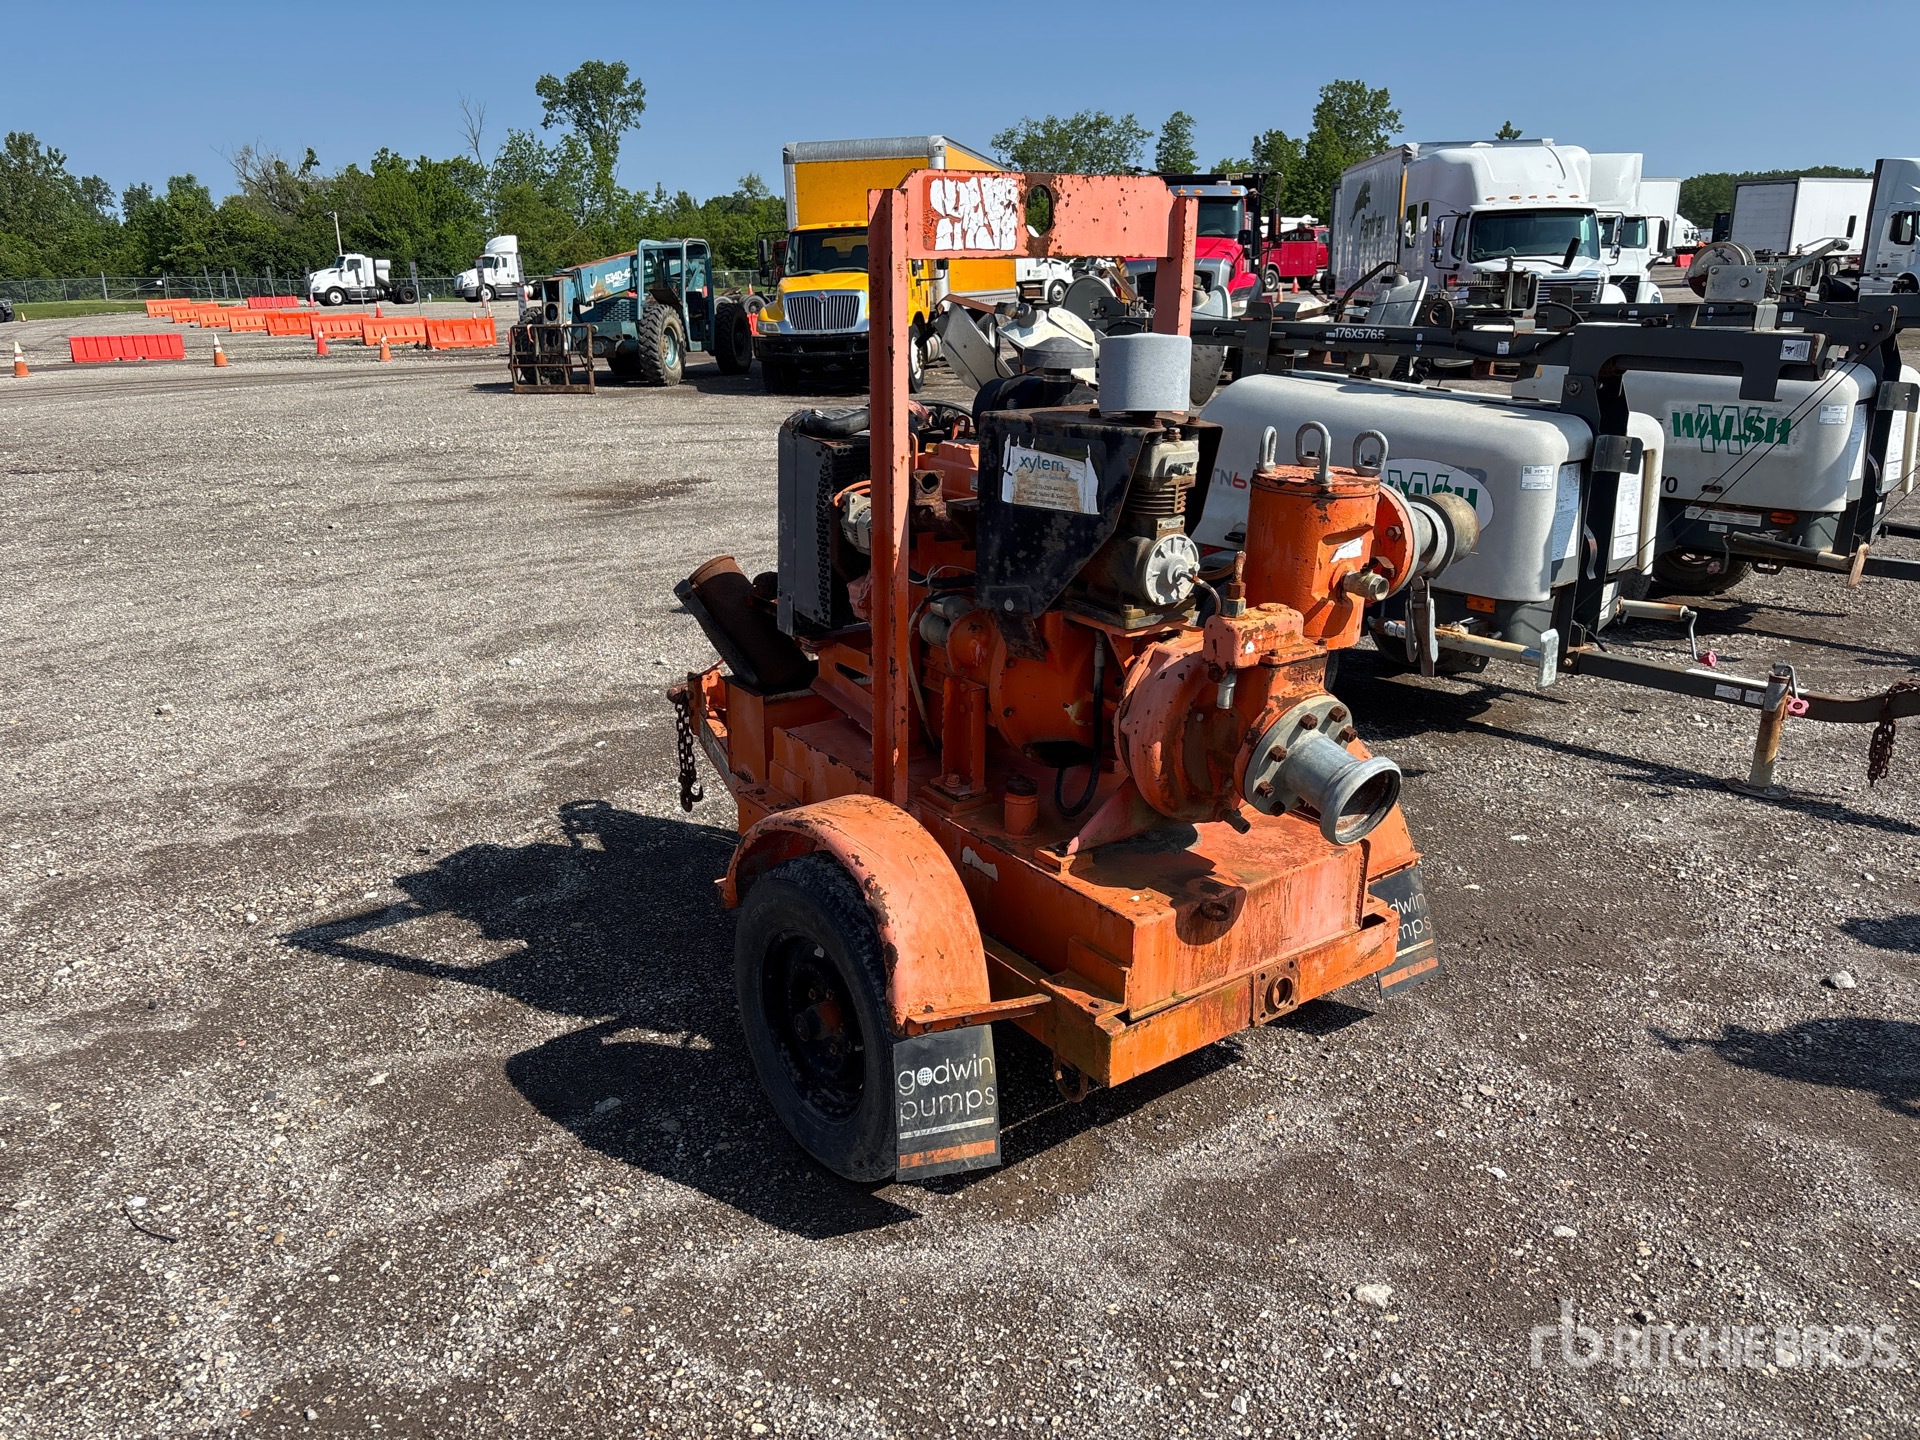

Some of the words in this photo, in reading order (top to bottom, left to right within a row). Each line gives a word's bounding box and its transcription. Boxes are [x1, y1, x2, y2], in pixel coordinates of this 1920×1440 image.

[1671, 411, 1792, 449] WALSH
[1019, 455, 1065, 473] xylem
[1389, 892, 1428, 916] dwin
[1398, 916, 1432, 942] mps
[897, 1053, 994, 1096] godwin
[899, 1086, 996, 1127] pumps
